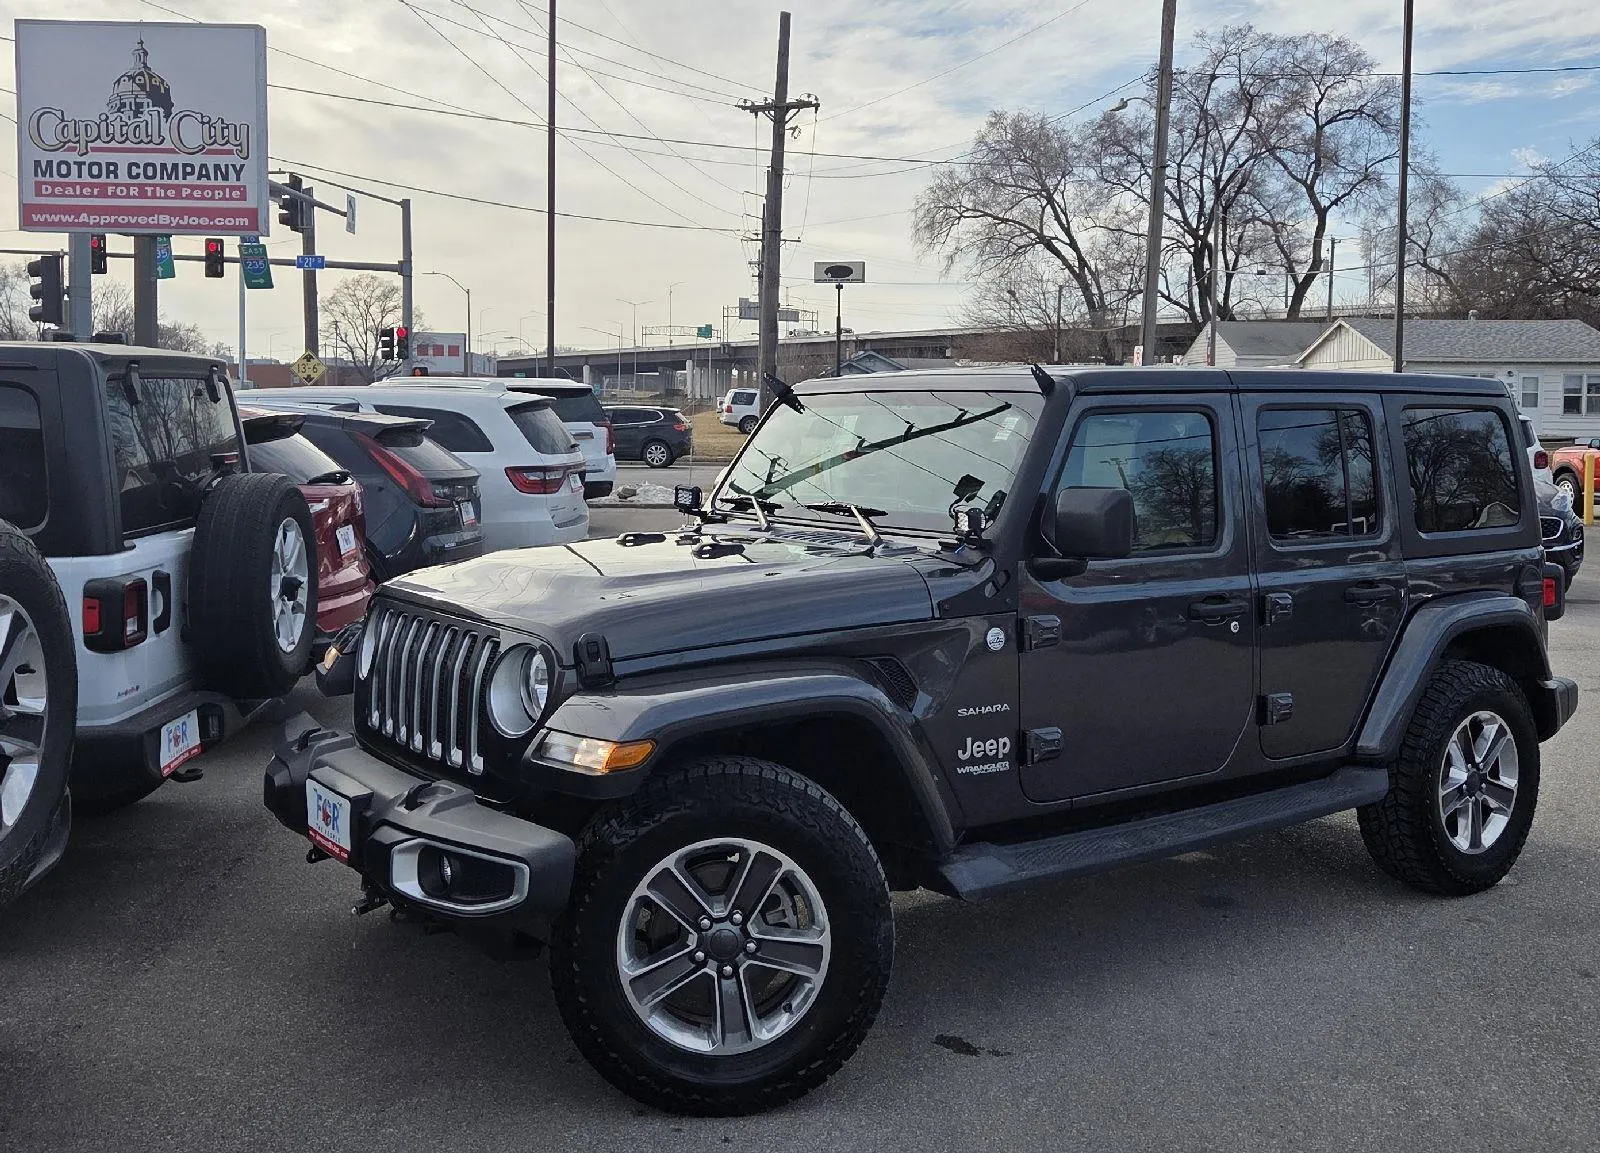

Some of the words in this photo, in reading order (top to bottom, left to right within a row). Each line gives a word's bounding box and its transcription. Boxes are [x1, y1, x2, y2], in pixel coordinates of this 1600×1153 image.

[28, 107, 166, 156] Capital
[169, 109, 250, 159] City
[33, 159, 119, 179] MOTOR
[126, 162, 246, 182] COMPANY
[41, 184, 100, 195] Dealer
[107, 186, 139, 196] FOR
[144, 186, 176, 198] The
[31, 212, 250, 227] www.ApprovedByJoe.com
[156, 249, 168, 259] 35
[242, 245, 264, 255] EAST
[246, 260, 265, 270] 235
[957, 703, 1011, 717] SAHARA
[957, 736, 1011, 761] Jeep
[956, 760, 1010, 774] WRANGLER
